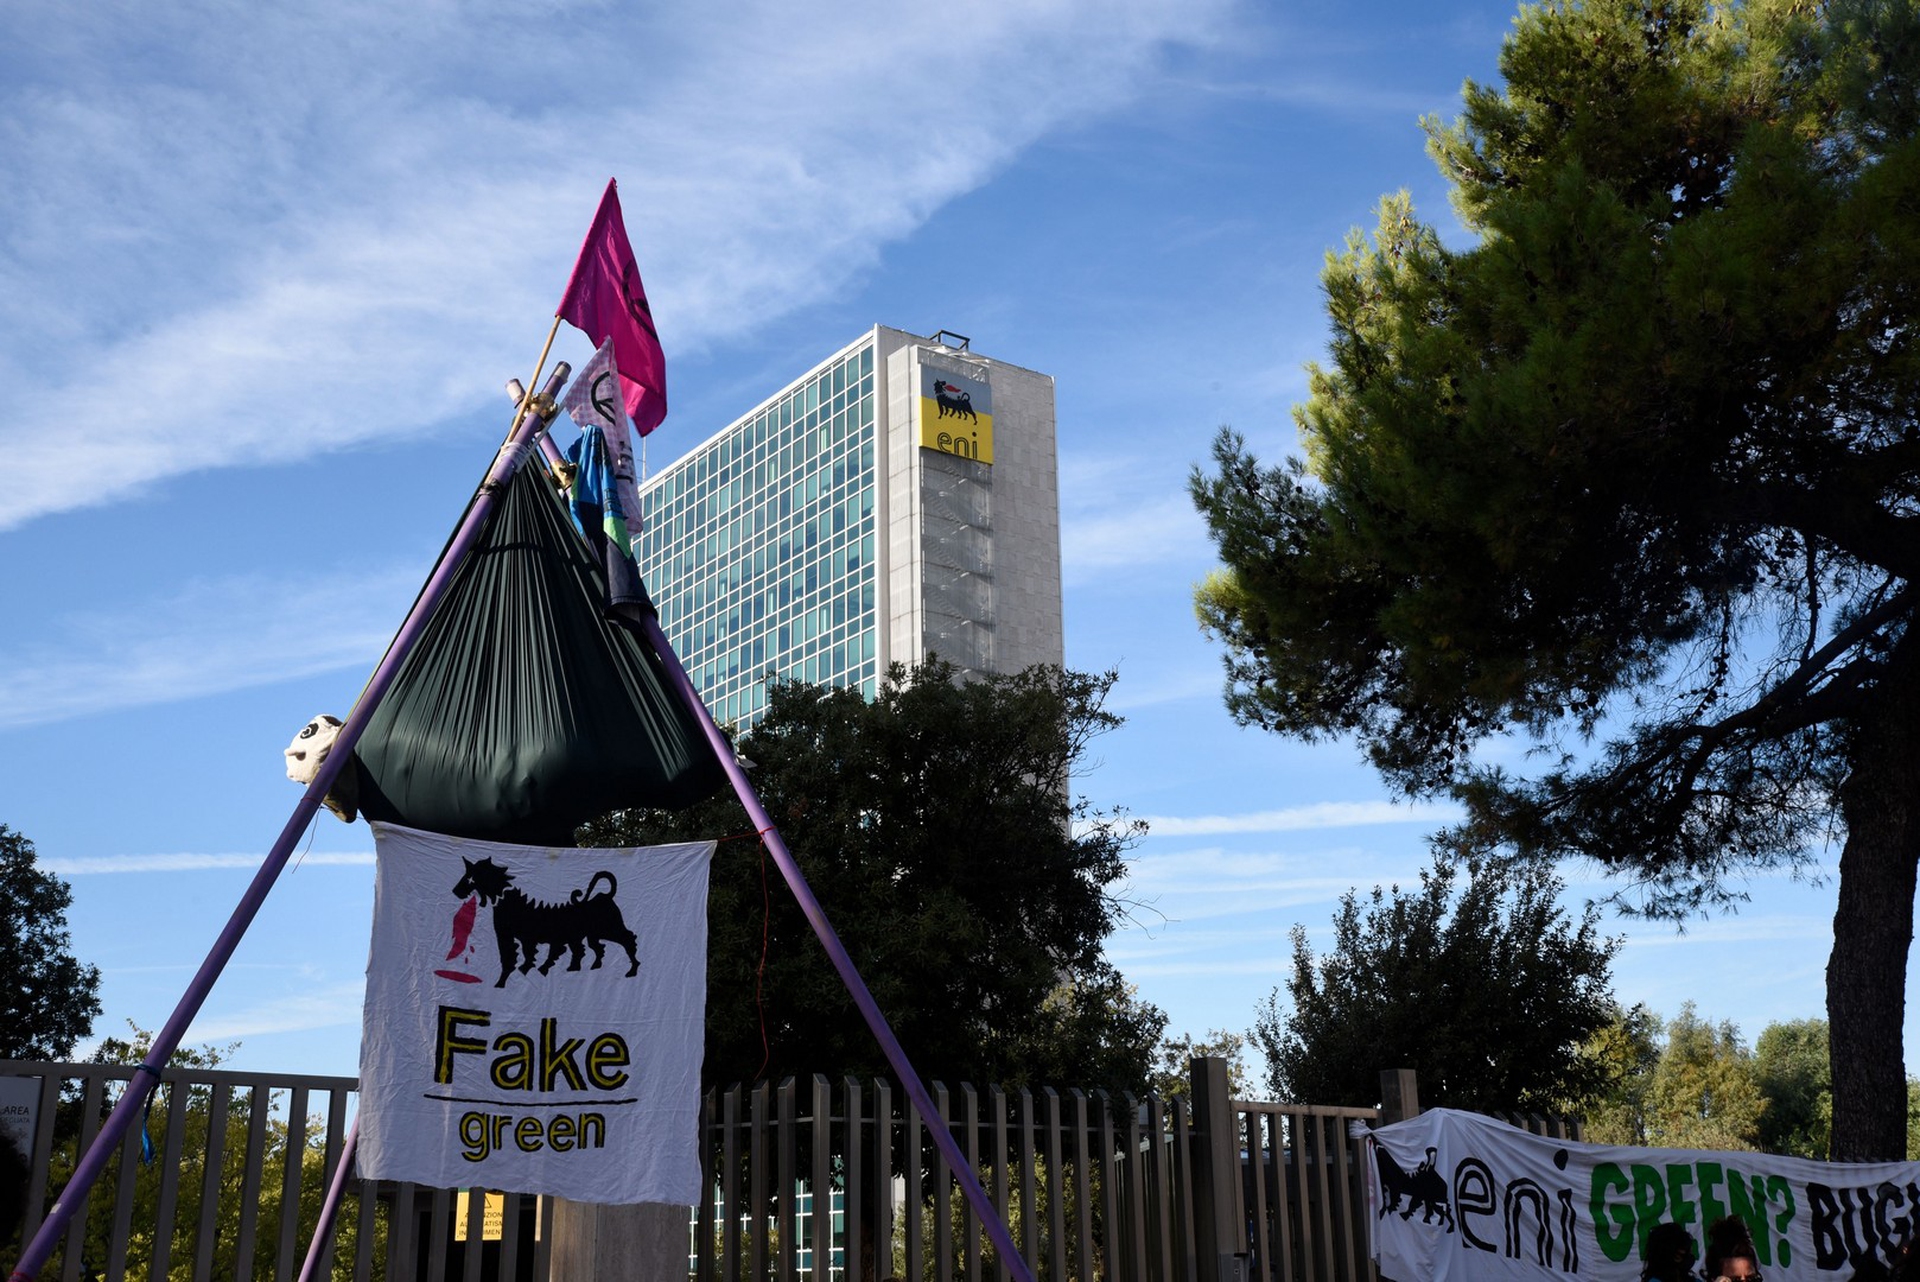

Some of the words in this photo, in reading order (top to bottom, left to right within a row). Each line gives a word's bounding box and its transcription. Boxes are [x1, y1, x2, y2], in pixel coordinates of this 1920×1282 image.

[937, 432, 977, 459] eni
[434, 1005, 630, 1092] Fake
[2, 1106, 29, 1115] AREA
[459, 1111, 606, 1162] green
[1454, 1148, 1579, 1274] eni
[1589, 1162, 1796, 1268] GREEN?
